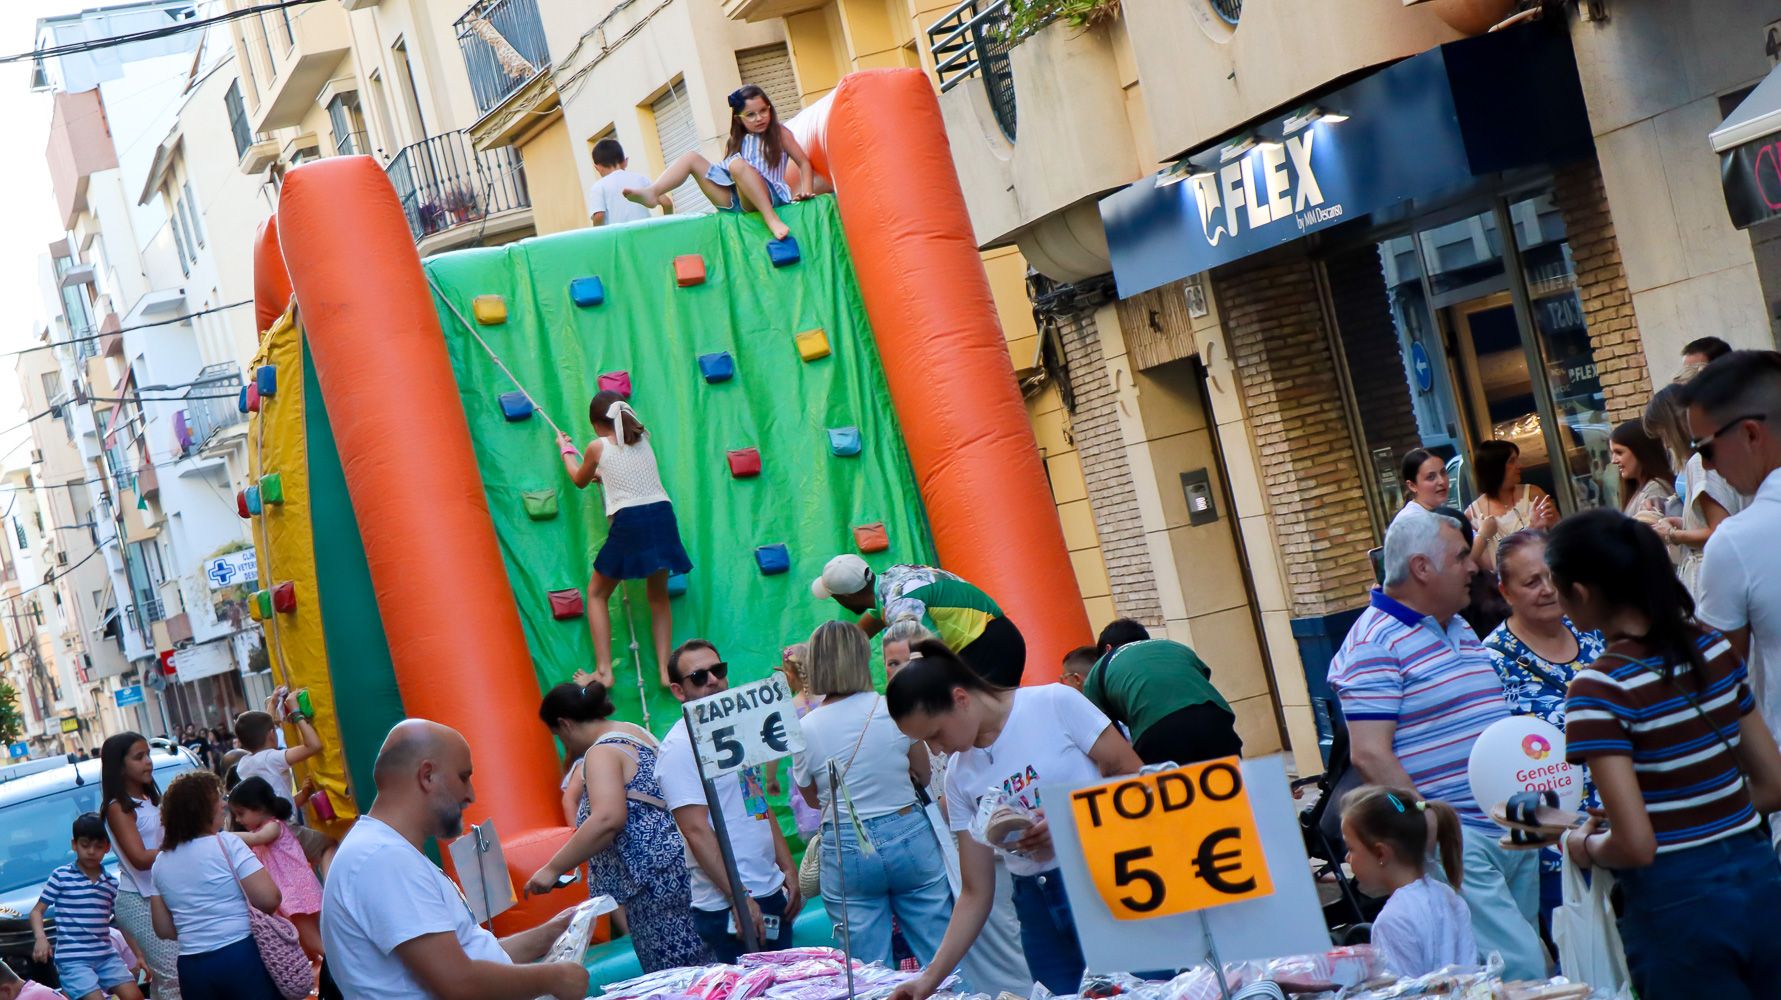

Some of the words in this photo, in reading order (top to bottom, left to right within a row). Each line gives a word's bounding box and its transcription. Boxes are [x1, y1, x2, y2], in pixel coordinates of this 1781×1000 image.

[1220, 128, 1324, 237] FLEX
[1295, 213, 1306, 233] by
[1303, 209, 1318, 227] MM
[1315, 203, 1343, 223] Descanso
[696, 681, 784, 724] ZAPATOS
[711, 725, 745, 770] 5
[760, 711, 789, 752] €
[1073, 762, 1243, 829] TODO
[1114, 845, 1167, 913] 5
[1191, 827, 1258, 895] €
